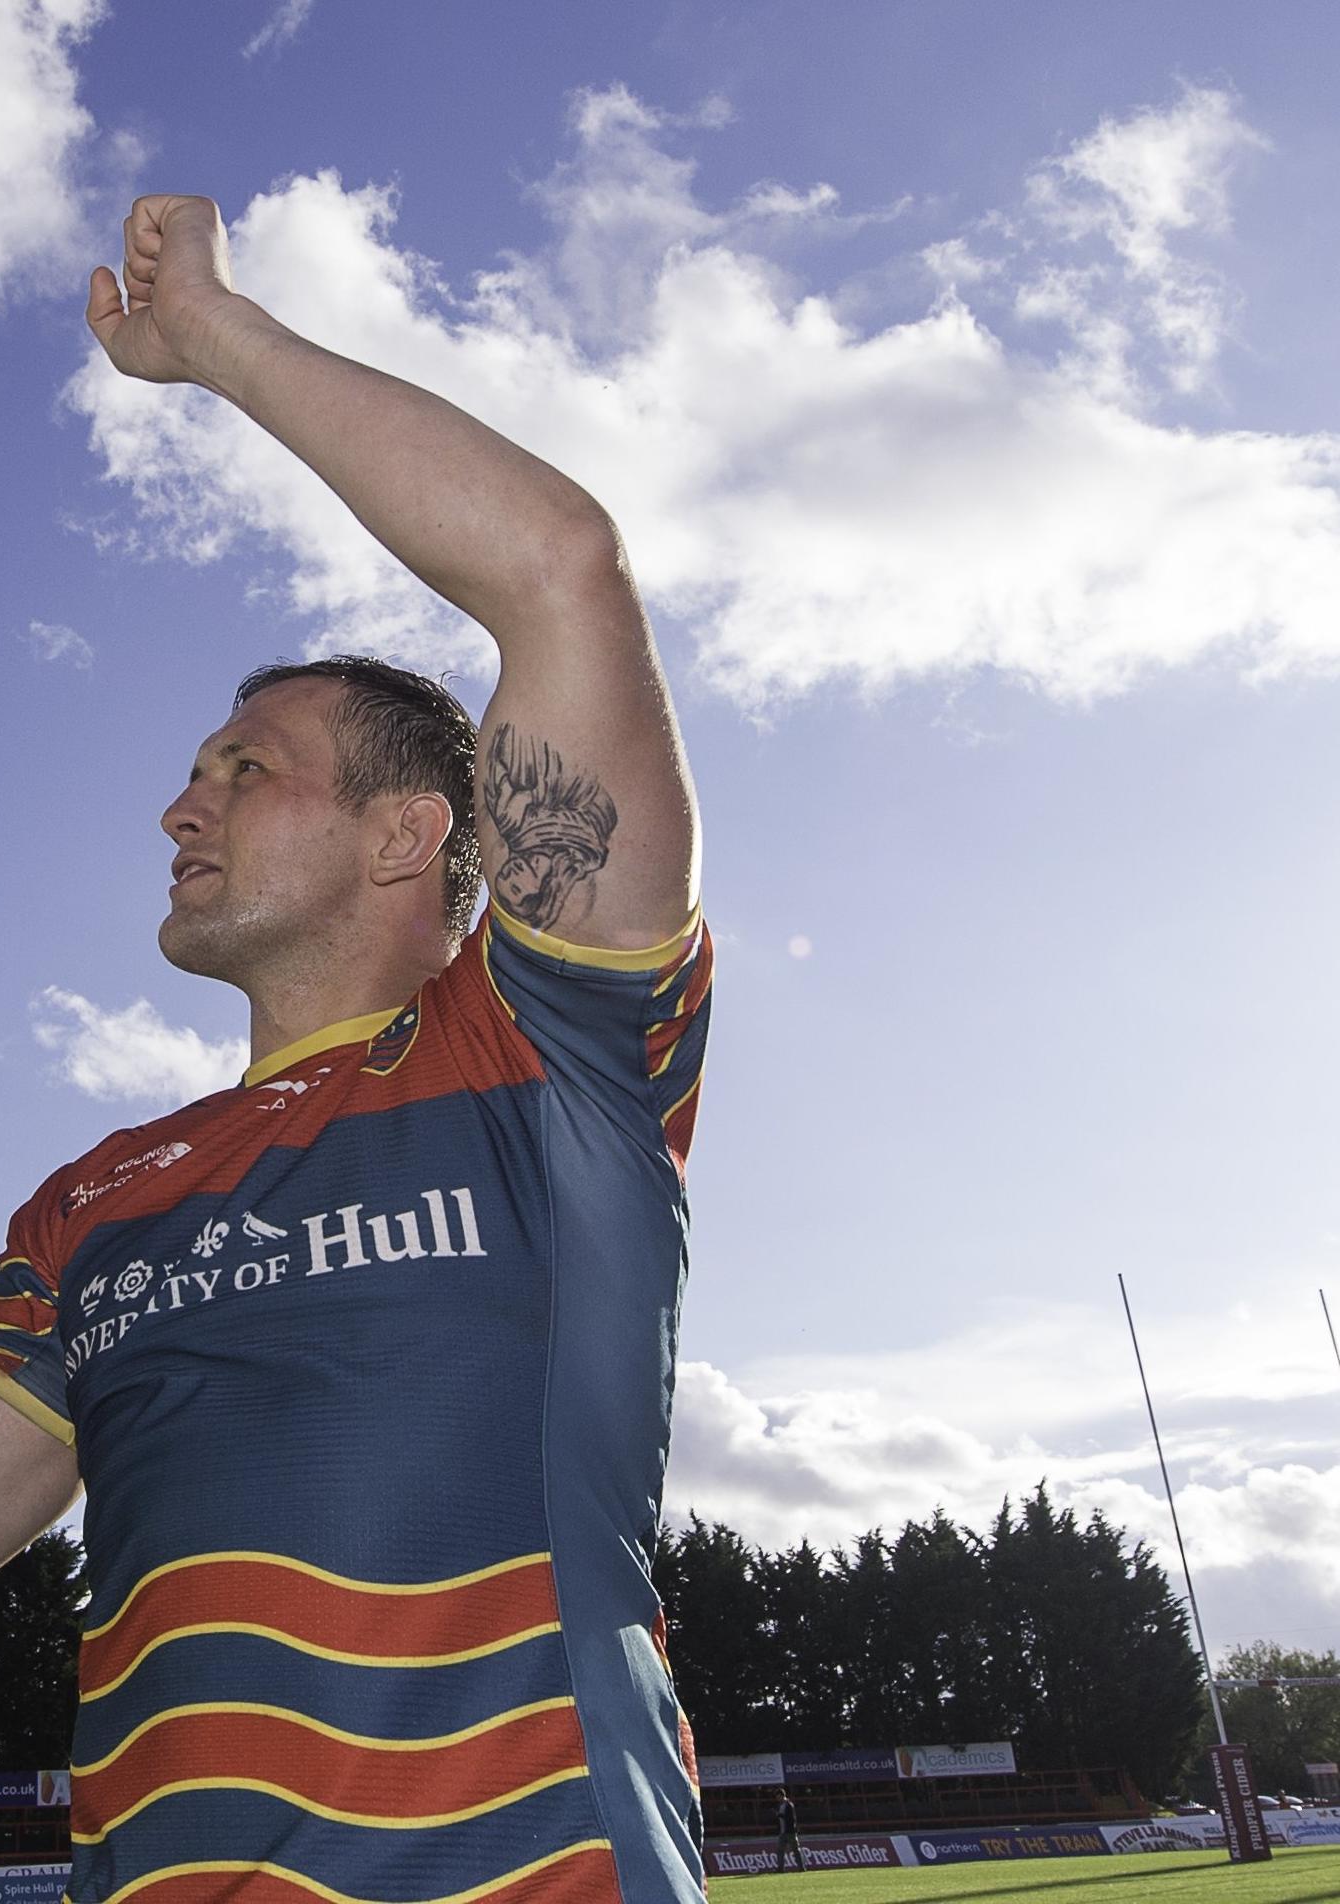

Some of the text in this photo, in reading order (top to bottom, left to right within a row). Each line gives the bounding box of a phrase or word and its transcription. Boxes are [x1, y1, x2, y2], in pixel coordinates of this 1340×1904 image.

[234, 1253, 290, 1291] OF
[301, 1187, 488, 1277] Hull
[702, 1759, 776, 1777] cademics
[784, 1758, 896, 1774] academicsltd.co.uk
[1232, 1757, 1252, 1797] CIDER
[1242, 1799, 1265, 1851] PROPER
[804, 1847, 846, 1865] Press
[846, 1844, 890, 1863] Cider
[936, 1834, 1104, 1856] northern TRY THE TRAIN
[4, 1884, 30, 1896] Spire
[33, 1882, 54, 1893] Hull
